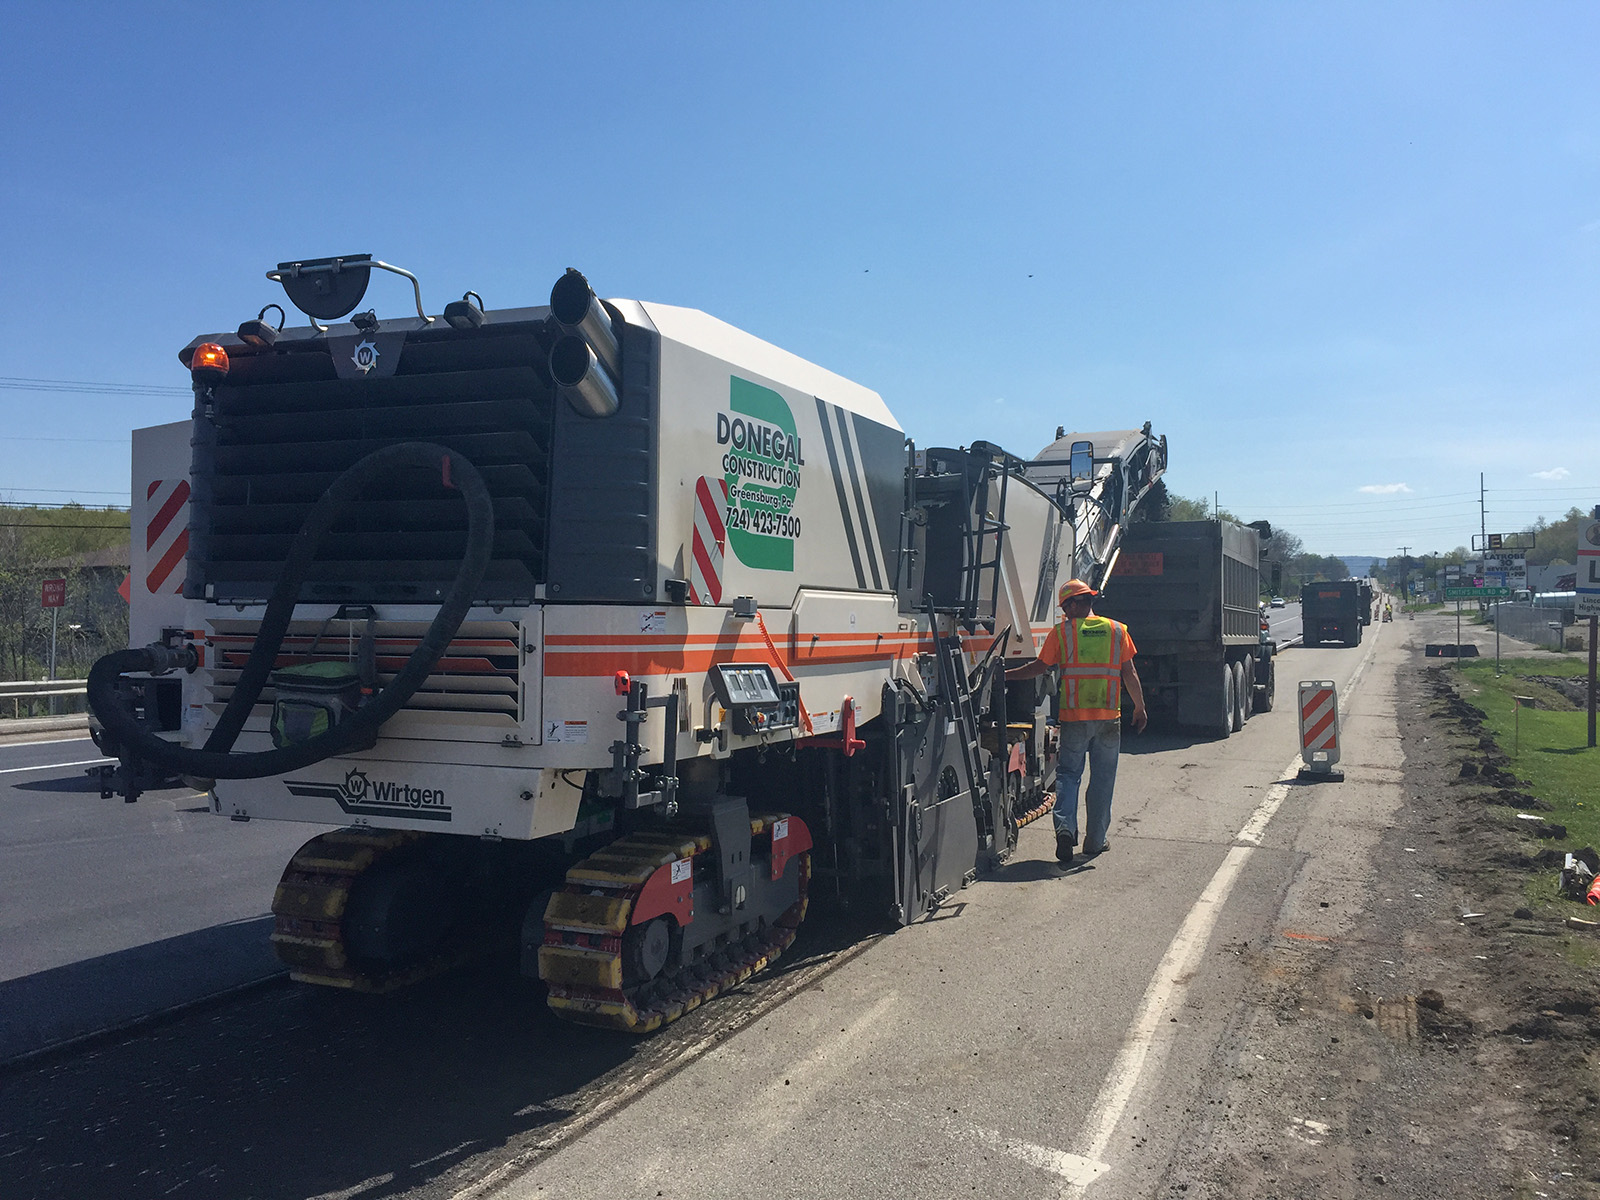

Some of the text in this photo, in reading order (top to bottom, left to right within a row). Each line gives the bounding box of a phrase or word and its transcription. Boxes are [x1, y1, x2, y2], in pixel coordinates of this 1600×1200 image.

[717, 412, 805, 466] DONEGAL
[722, 453, 801, 489] CONSTRUCTION
[730, 485, 794, 509] Greensburg, Pa.
[752, 512, 801, 538] 423-7500
[44, 583, 64, 592] WRONG
[372, 781, 445, 808] Wirtgen
